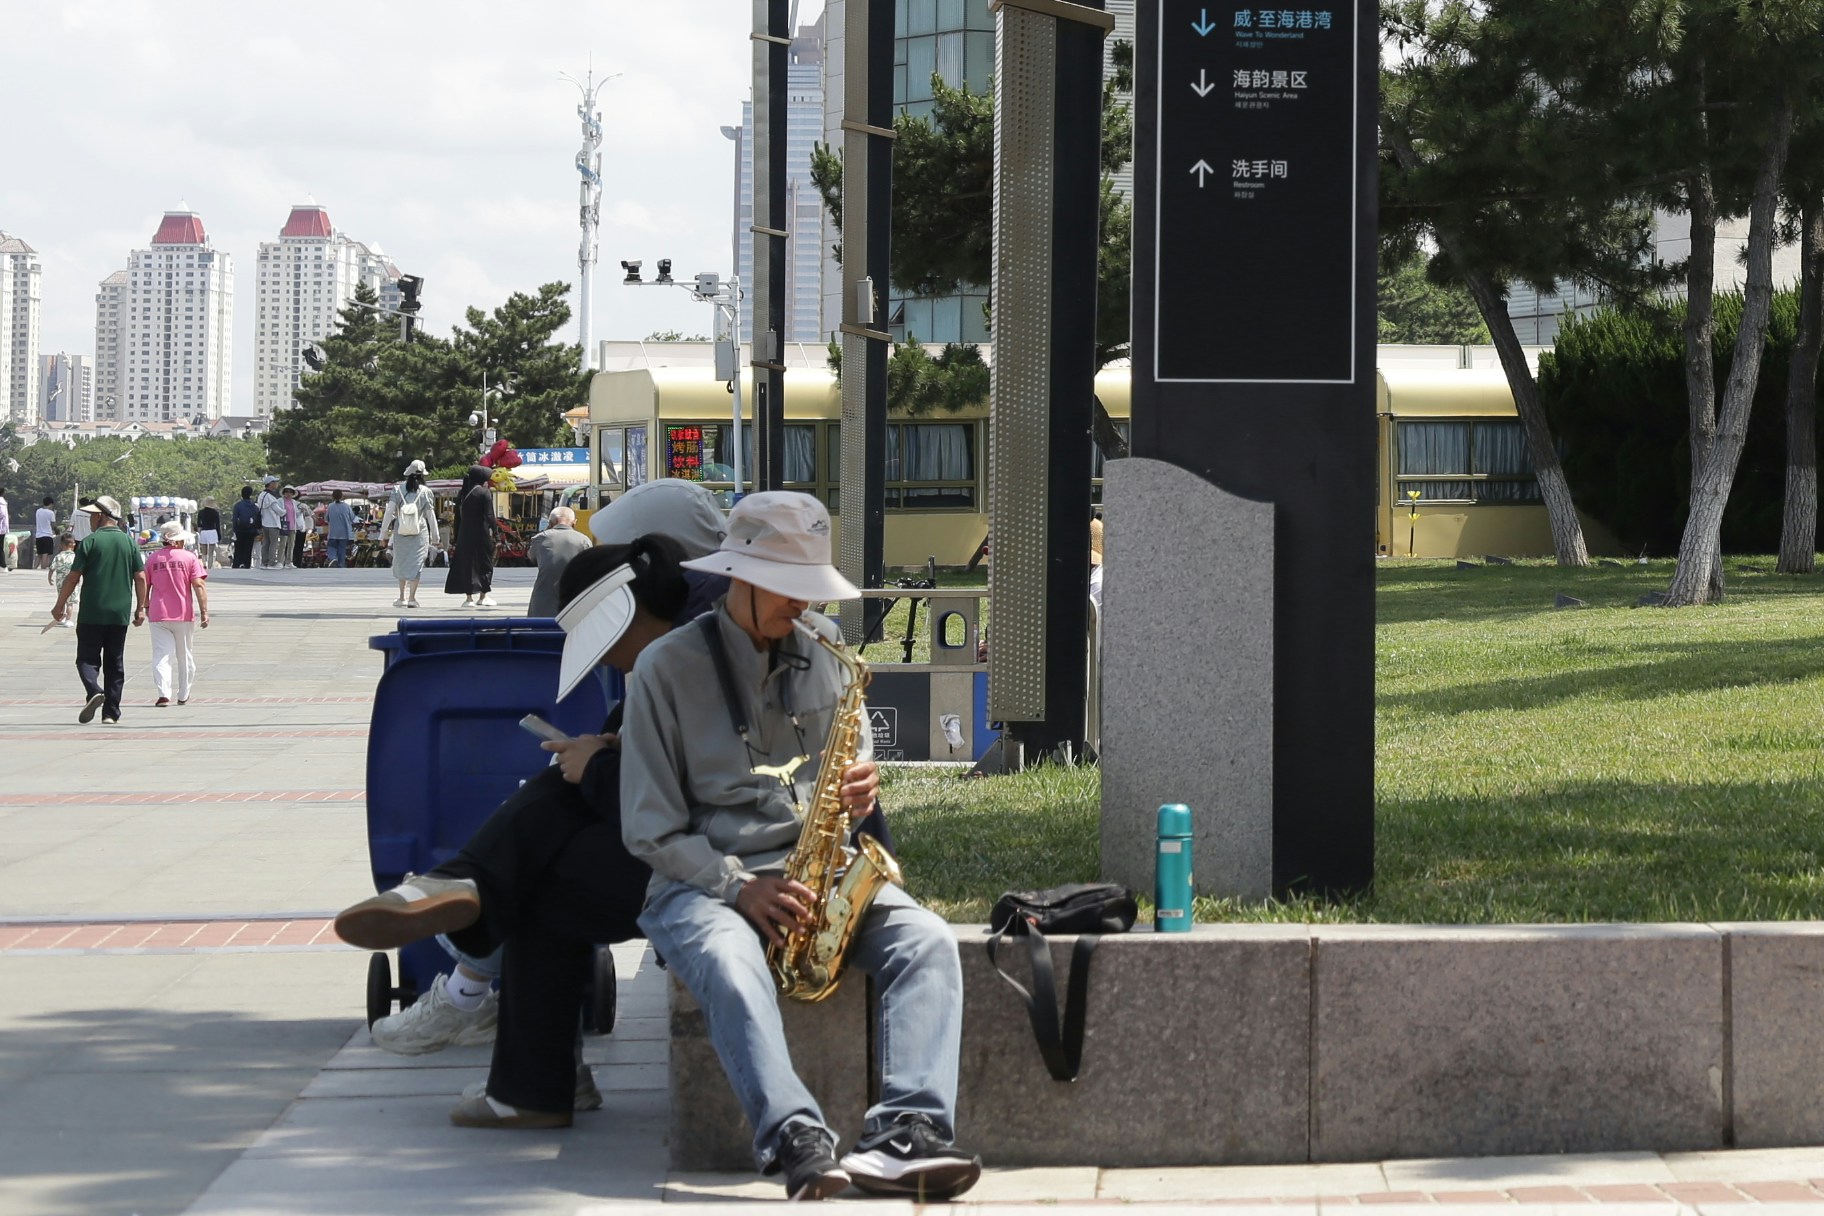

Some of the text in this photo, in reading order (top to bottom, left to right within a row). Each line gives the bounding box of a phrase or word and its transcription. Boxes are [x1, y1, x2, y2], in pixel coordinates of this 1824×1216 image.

[1265, 31, 1304, 39] Wonderland
[1233, 69, 1308, 89] 海韵景区
[1234, 91, 1258, 100] Haiyun
[1232, 159, 1288, 178] 洗手间
[672, 441, 699, 454] 烤肠
[672, 455, 700, 468] 饮料
